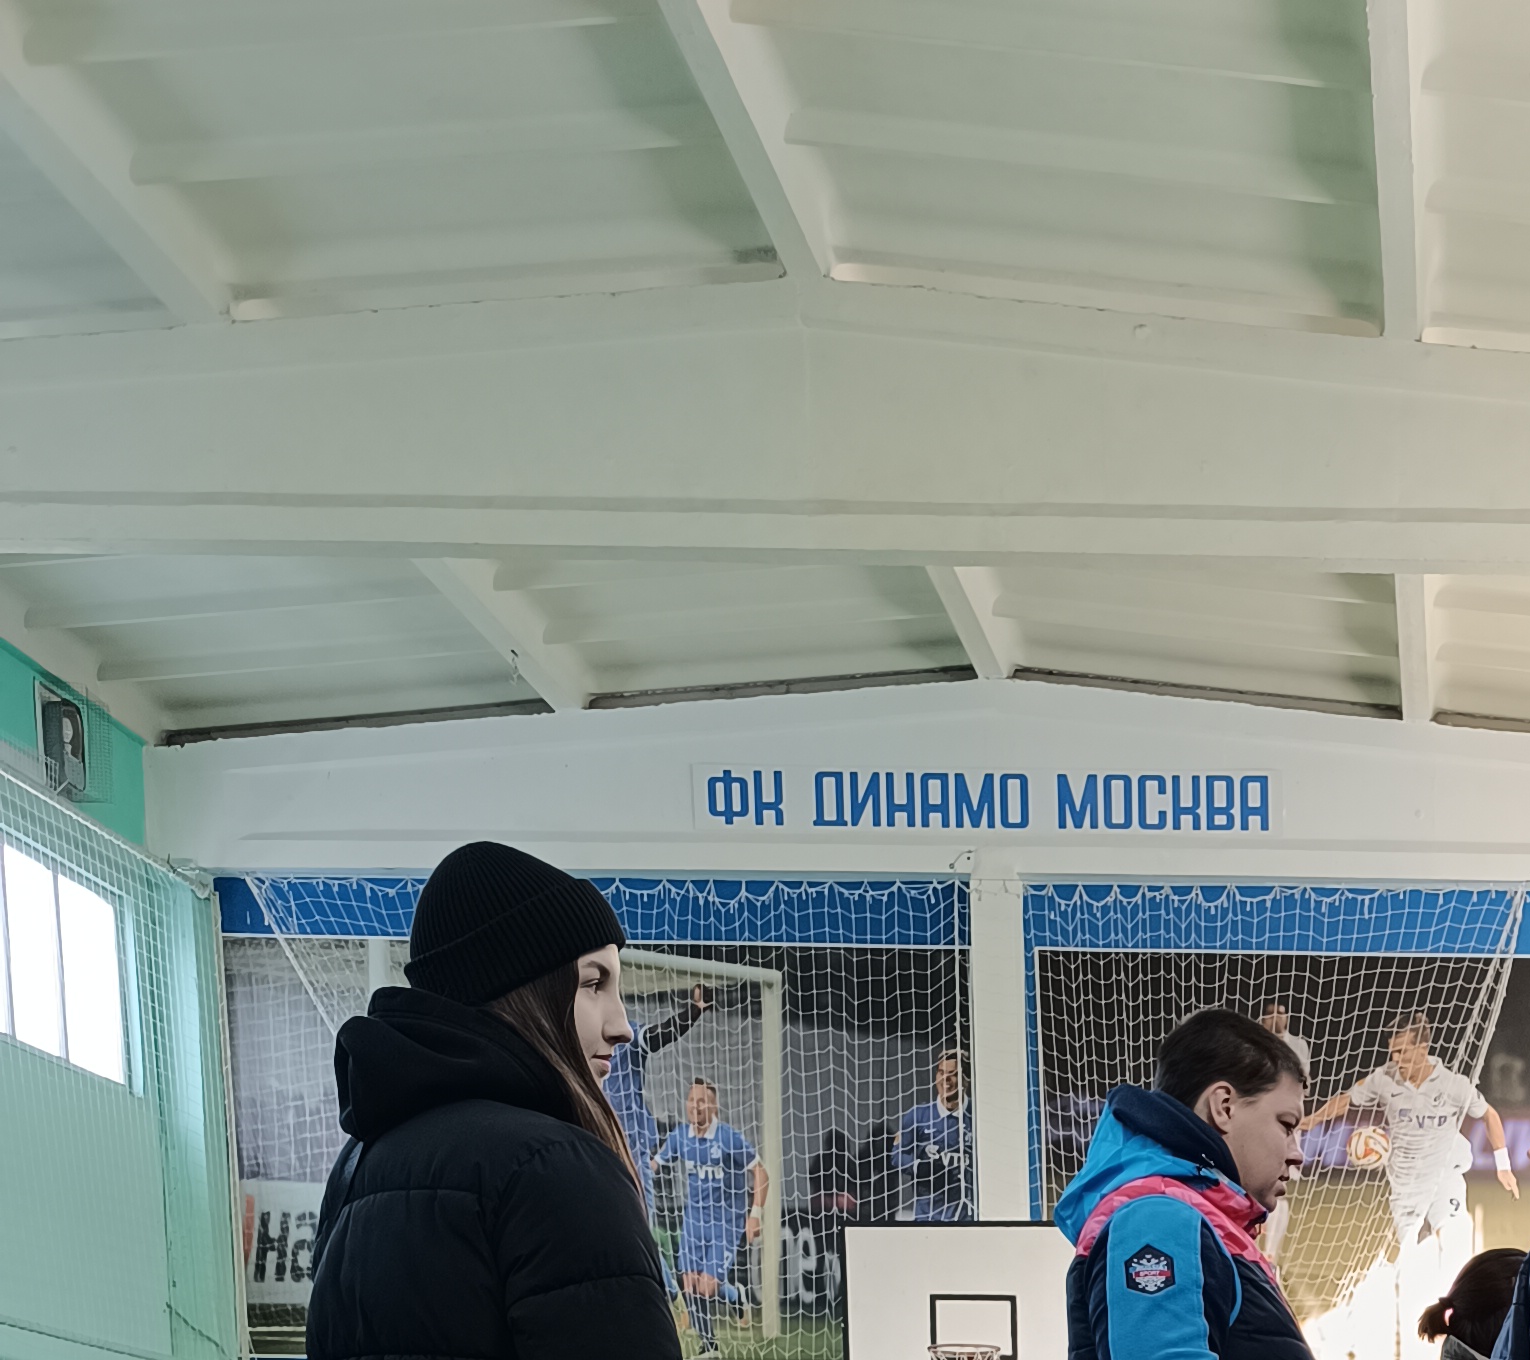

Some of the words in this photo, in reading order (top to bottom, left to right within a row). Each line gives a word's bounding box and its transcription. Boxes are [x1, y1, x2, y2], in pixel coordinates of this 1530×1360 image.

[707, 769, 784, 827] ФК
[812, 771, 1029, 829] ДИНАМО
[1056, 773, 1270, 832] МОСКВА
